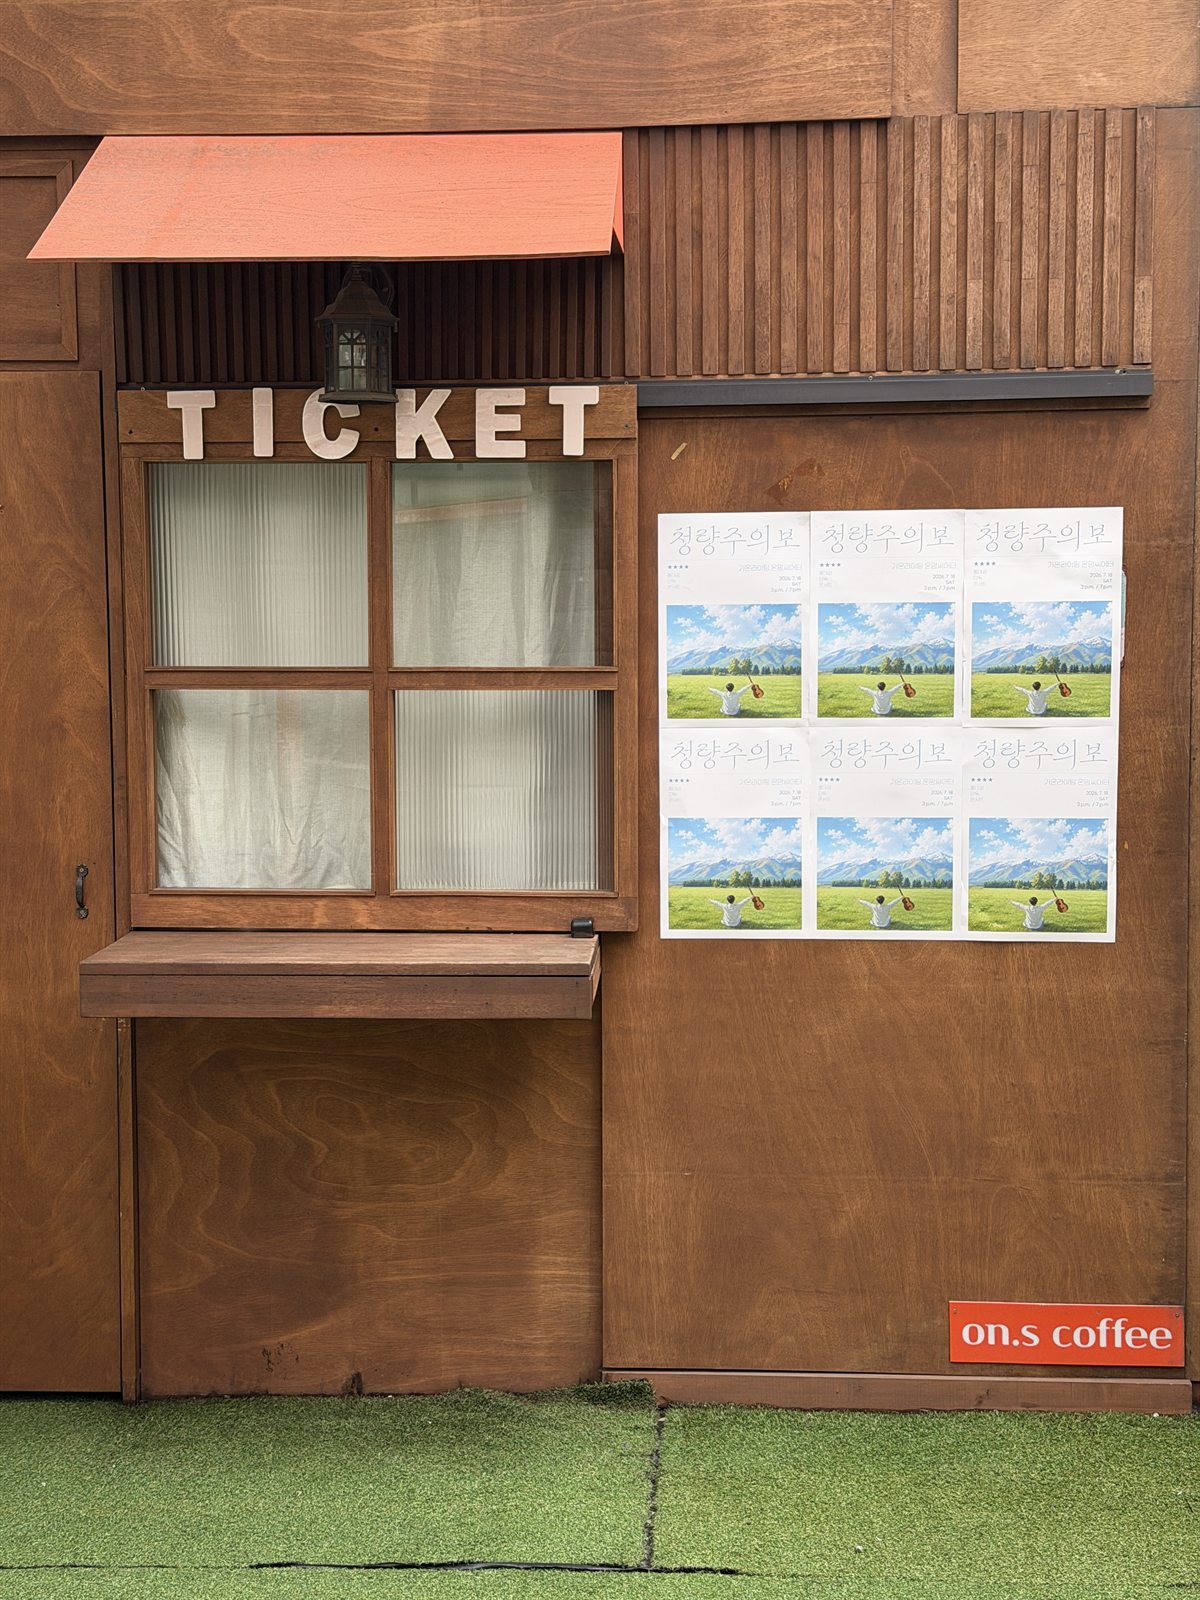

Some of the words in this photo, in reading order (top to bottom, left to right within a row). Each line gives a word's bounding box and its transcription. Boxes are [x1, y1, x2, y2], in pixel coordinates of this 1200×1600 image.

[166, 386, 599, 460] TICKET
[670, 523, 800, 555] 청량주의보
[822, 522, 955, 553] 청량주의보
[976, 520, 1112, 552] 청량주의보
[671, 740, 800, 769] 청량주의보
[820, 739, 952, 769] 청량주의보
[973, 739, 1108, 770] 청량주의보
[961, 1322, 1040, 1347] on.s
[1052, 1318, 1173, 1349] coffee
